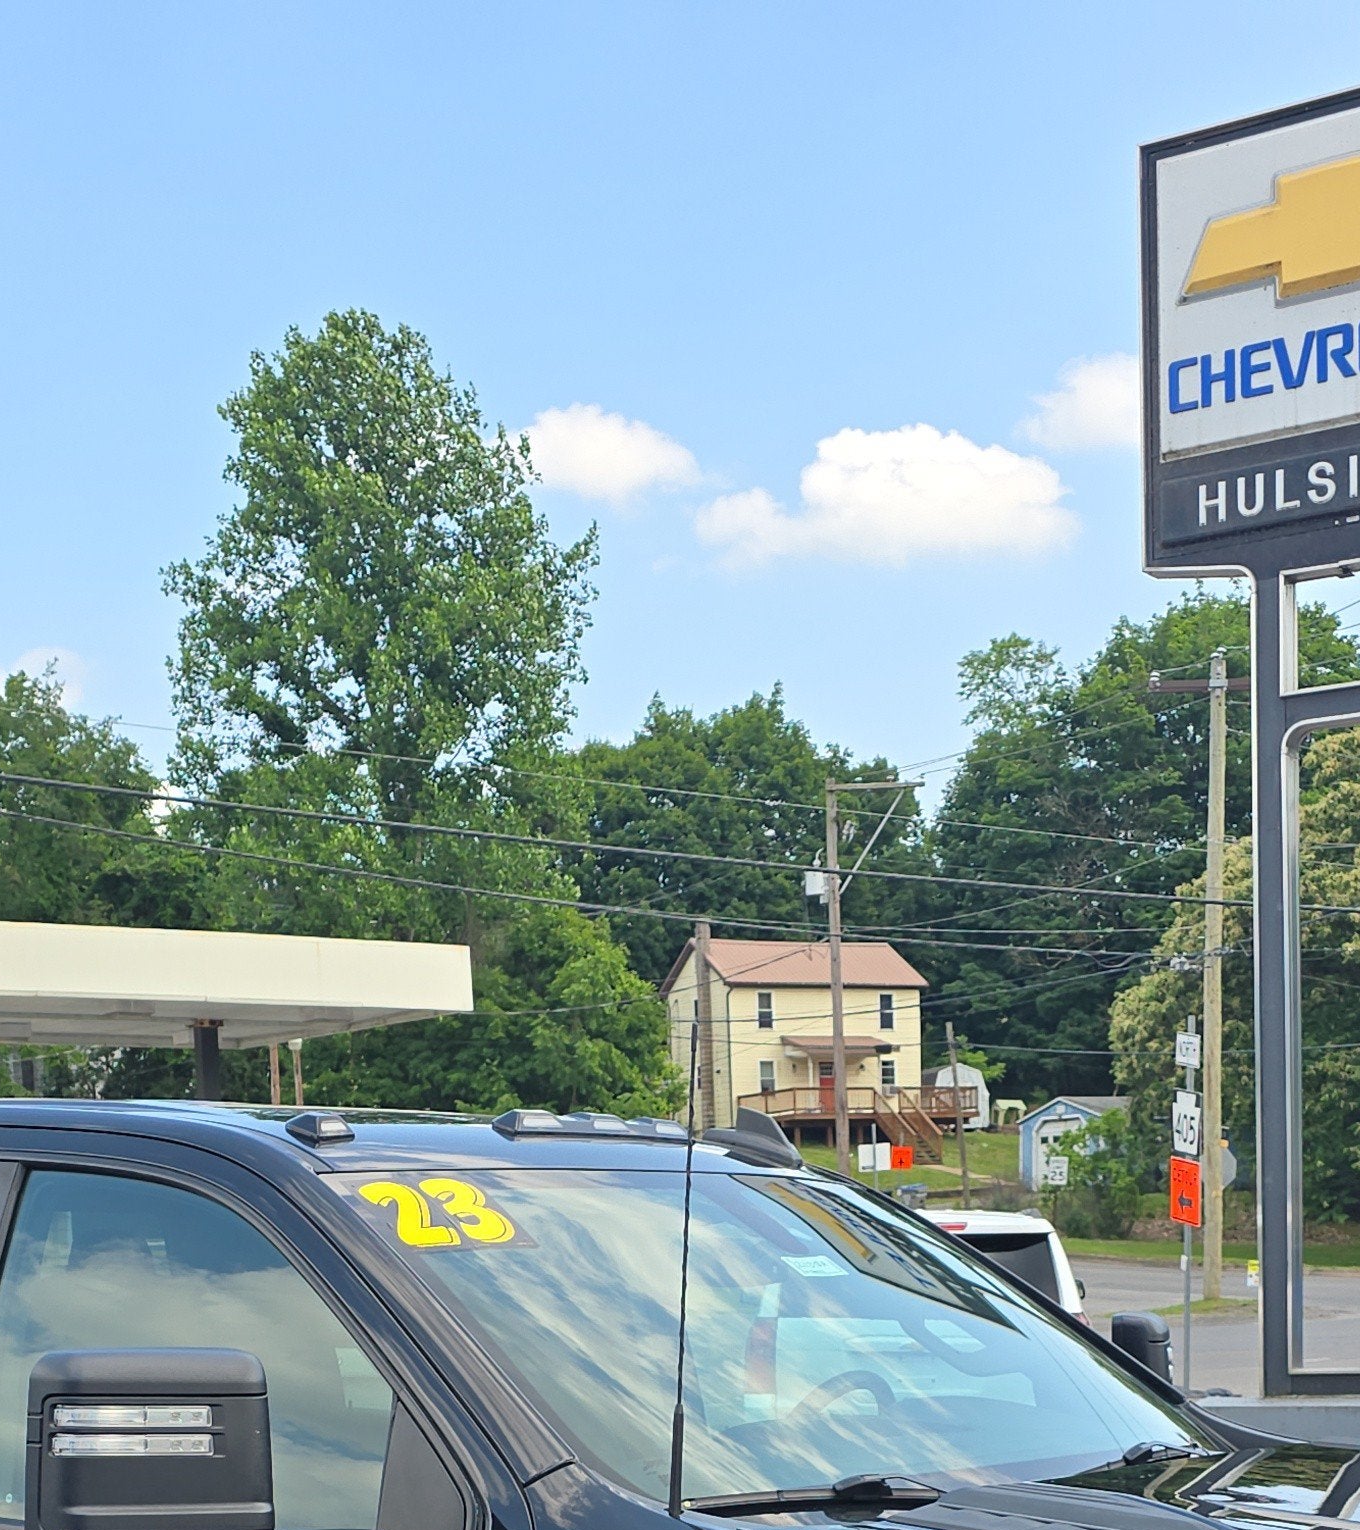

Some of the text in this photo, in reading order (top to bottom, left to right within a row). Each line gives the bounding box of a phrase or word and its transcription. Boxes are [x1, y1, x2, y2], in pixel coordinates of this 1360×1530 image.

[1175, 1112, 1196, 1146] 405
[1050, 1170, 1065, 1181] 25
[358, 1178, 516, 1247] 23
